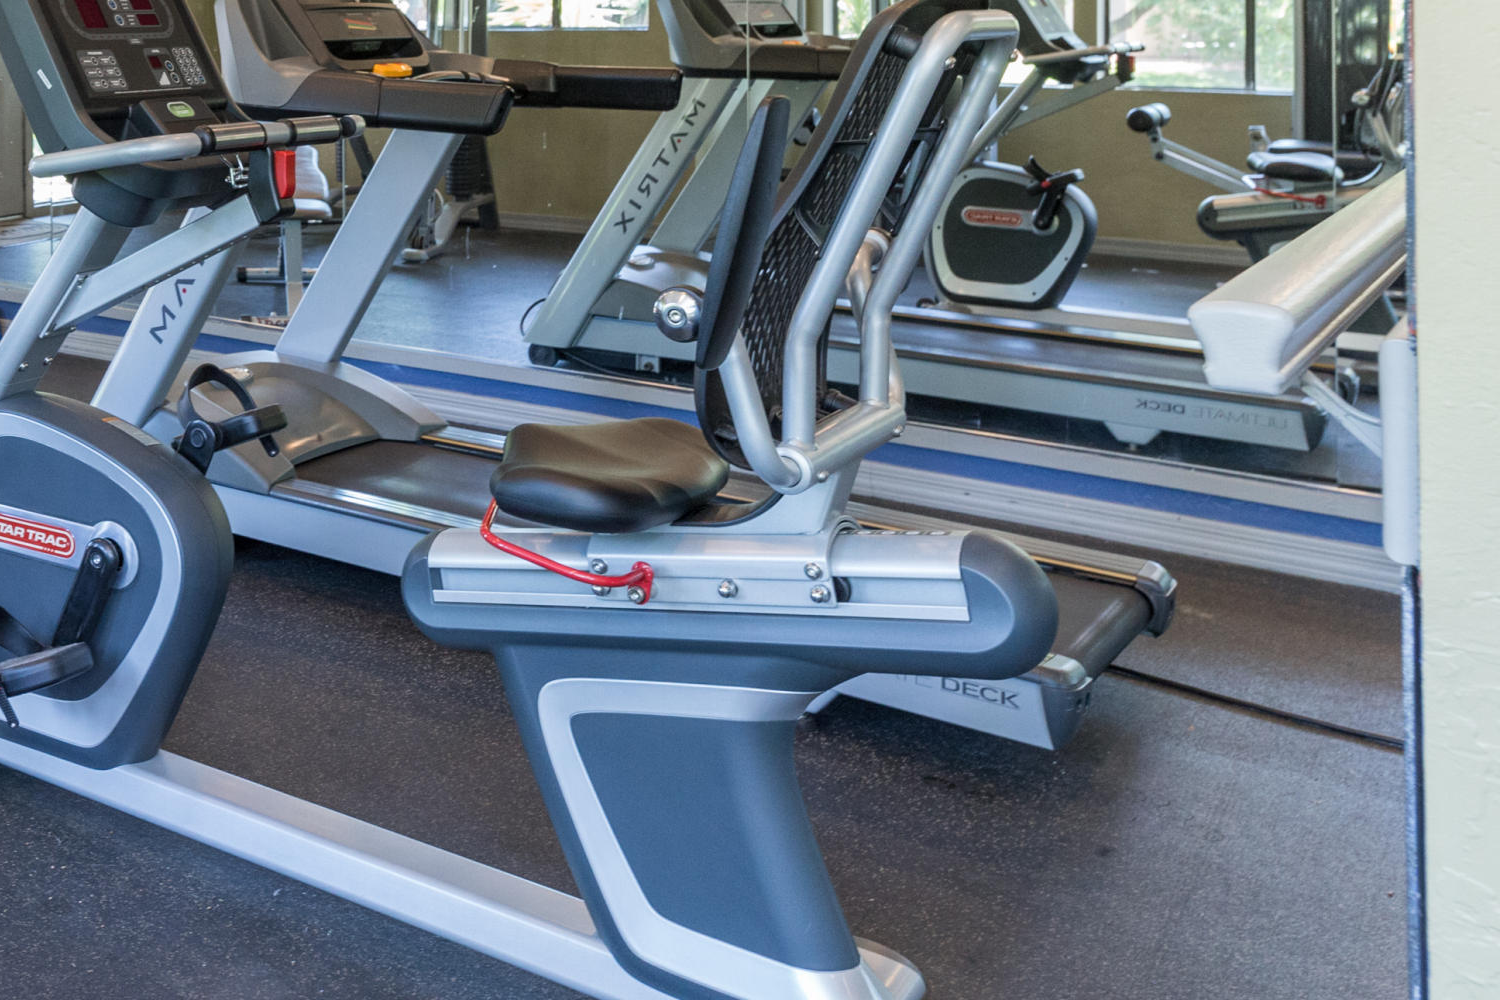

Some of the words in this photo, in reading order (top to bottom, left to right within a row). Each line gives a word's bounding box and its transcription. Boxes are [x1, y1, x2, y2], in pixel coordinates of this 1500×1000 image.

[149, 262, 204, 345] MA
[26, 528, 68, 548] TRAC
[941, 677, 1020, 709] DECK
